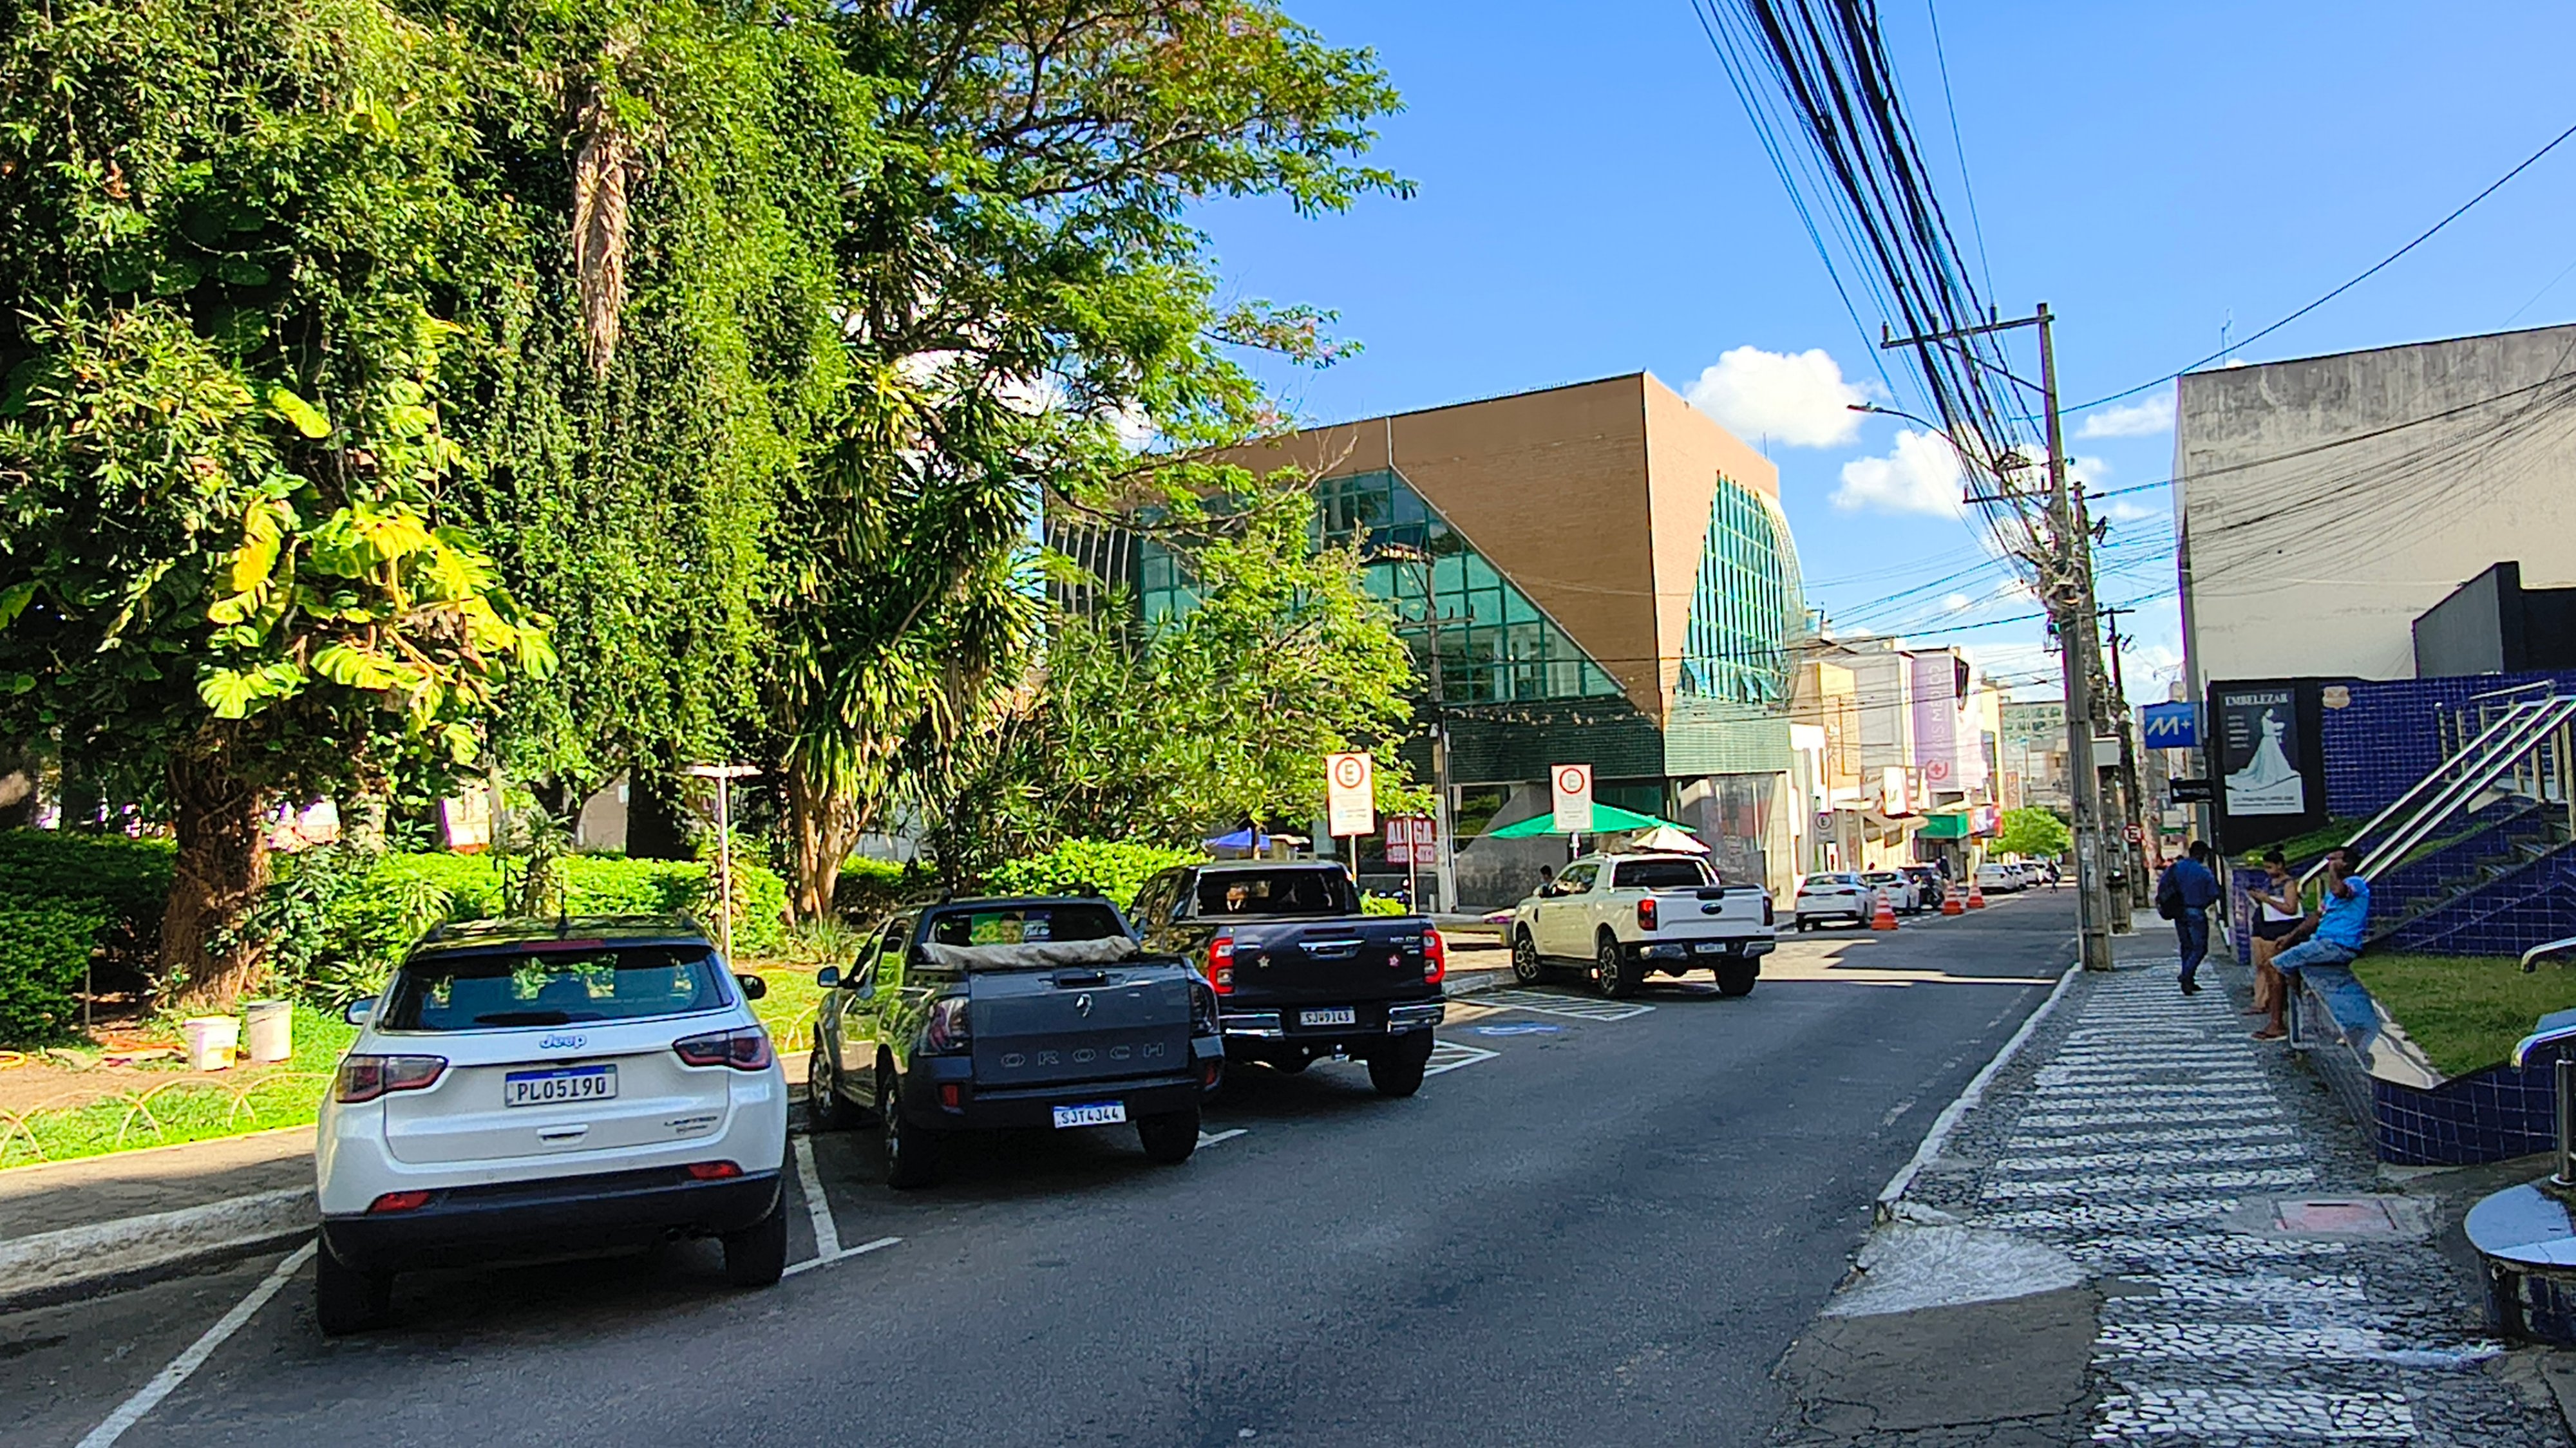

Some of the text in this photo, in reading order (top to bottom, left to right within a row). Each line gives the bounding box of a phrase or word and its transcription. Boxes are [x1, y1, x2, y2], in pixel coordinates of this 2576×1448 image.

[2224, 693, 2288, 706] EMBELEZAR
[1344, 764, 1354, 782] E
[1567, 774, 1577, 788] E
[539, 1033, 587, 1049] Jeep
[1000, 1042, 1164, 1067] OROCH
